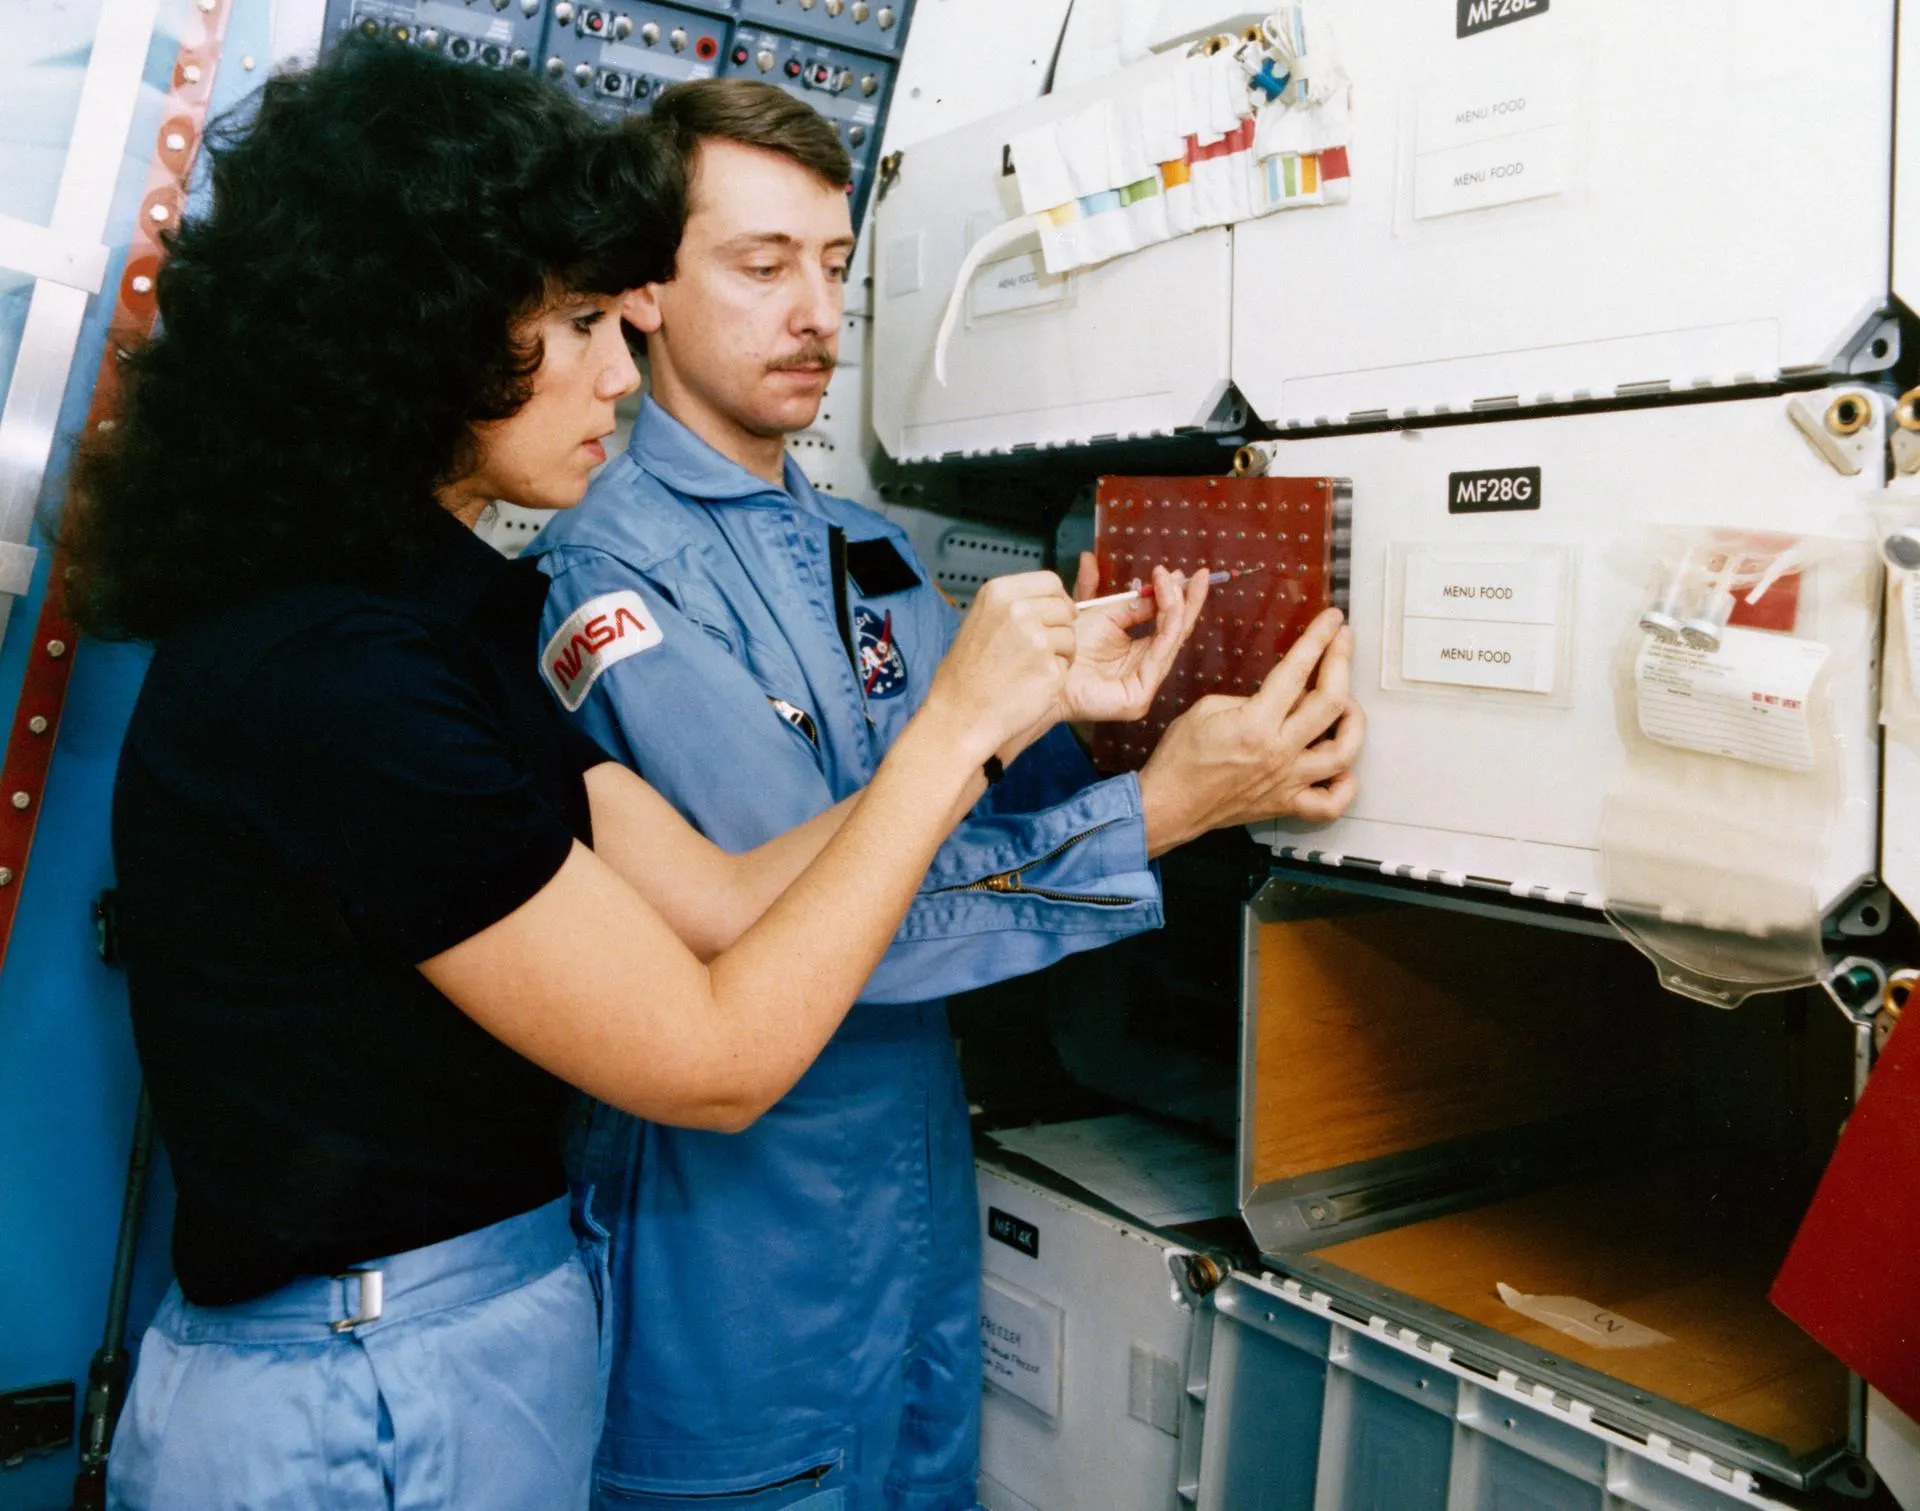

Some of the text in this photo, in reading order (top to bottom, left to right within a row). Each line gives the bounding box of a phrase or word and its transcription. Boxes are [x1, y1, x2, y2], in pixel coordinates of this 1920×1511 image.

[1454, 97, 1526, 125] MENU FOOD
[1452, 161, 1524, 187] MENU FOOD
[1456, 476, 1532, 503] MF28G
[1442, 586, 1513, 600] MENU FOOD
[552, 607, 646, 691] NASA
[1440, 648, 1512, 664] MENU FOOD
